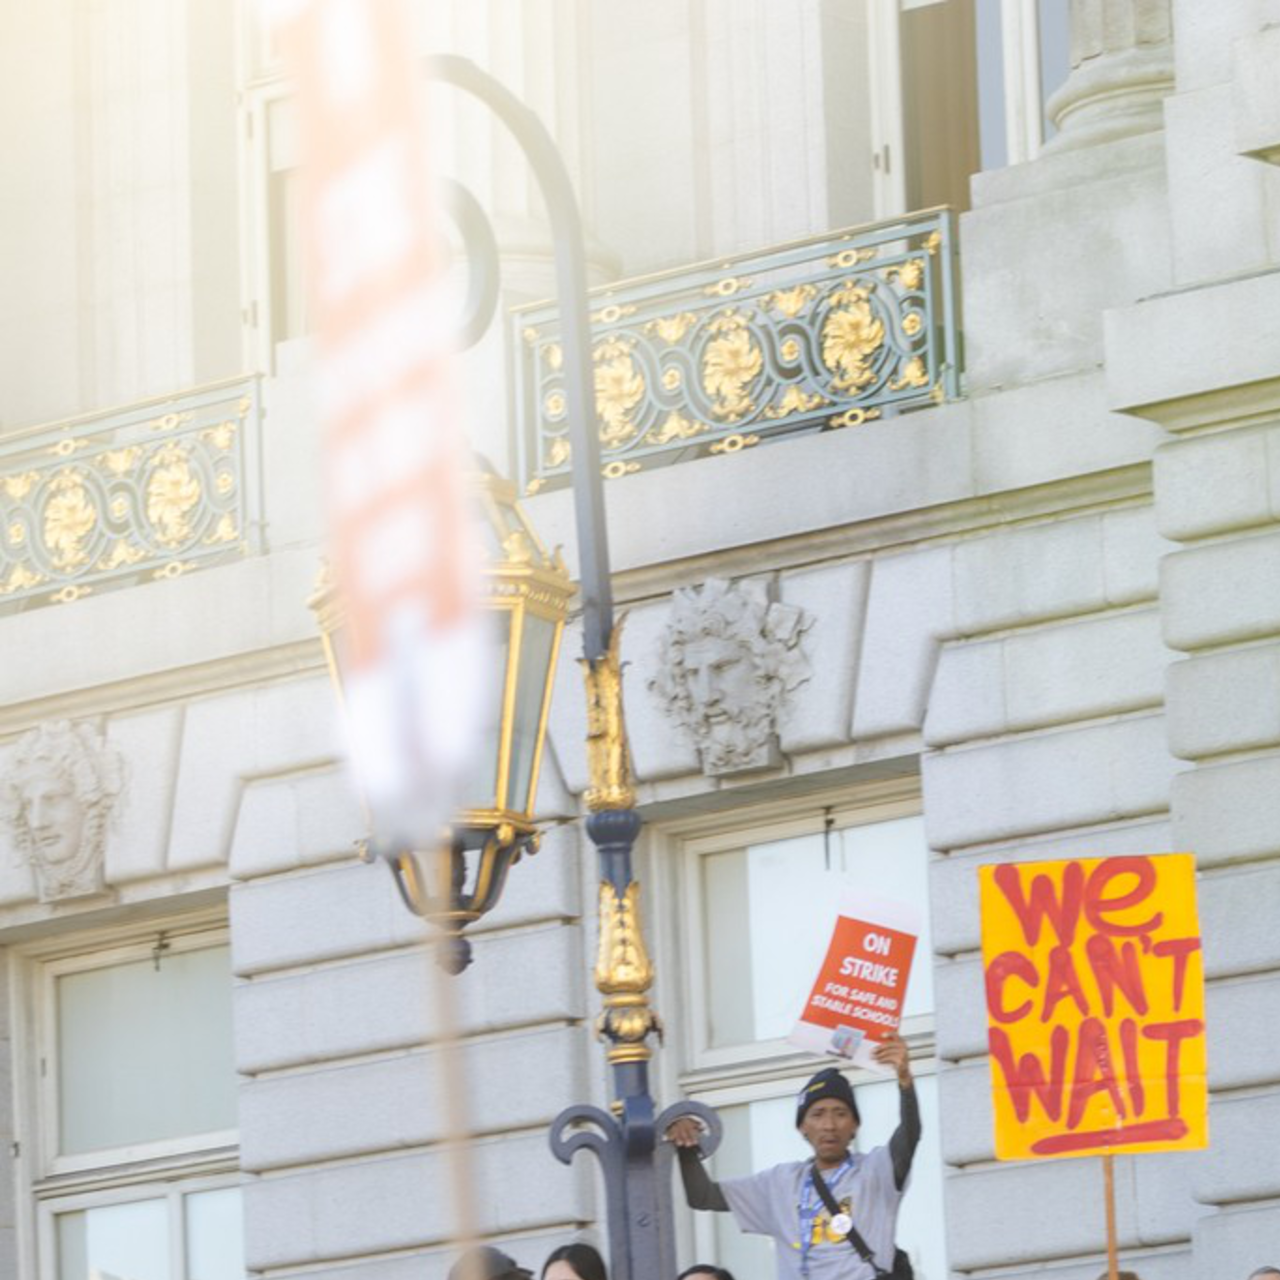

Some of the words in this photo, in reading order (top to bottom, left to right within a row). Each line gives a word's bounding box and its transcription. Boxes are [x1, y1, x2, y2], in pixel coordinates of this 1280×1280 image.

[994, 855, 1163, 947] We
[863, 933, 891, 955] ON
[839, 956, 899, 988] STRIKE
[985, 933, 1202, 1024] CAN'T
[810, 994, 851, 1014] STABLE
[824, 982, 849, 998] FOR
[848, 988, 876, 1004] SAFE
[876, 997, 898, 1010] AND
[988, 1017, 1203, 1130] WAIT
